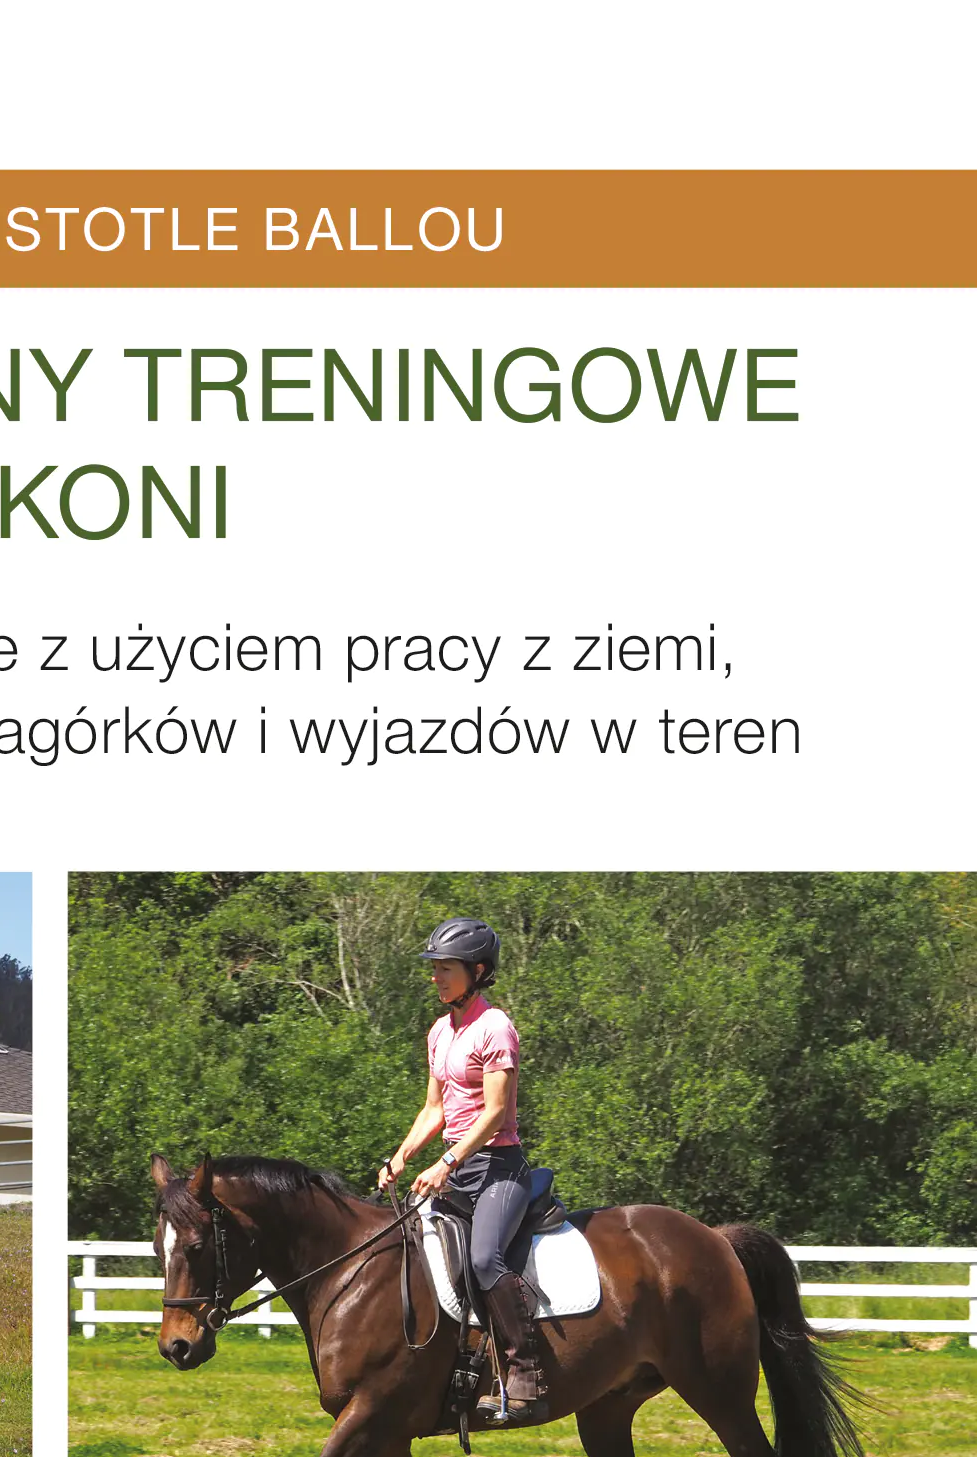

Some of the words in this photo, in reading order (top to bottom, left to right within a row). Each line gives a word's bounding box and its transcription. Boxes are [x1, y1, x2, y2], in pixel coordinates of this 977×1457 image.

[266, 207, 502, 252] BALLOU
[124, 347, 799, 423] TRENINGOWE
[0, 464, 226, 540] KONI
[41, 636, 68, 670] z
[93, 623, 320, 683] użyciem
[348, 636, 501, 683] pracy
[523, 636, 551, 670] z
[574, 623, 731, 679] ziemi,
[260, 705, 266, 754] i
[290, 706, 570, 766] wyjazdów
[591, 719, 637, 753] w
[659, 709, 799, 754] teren
